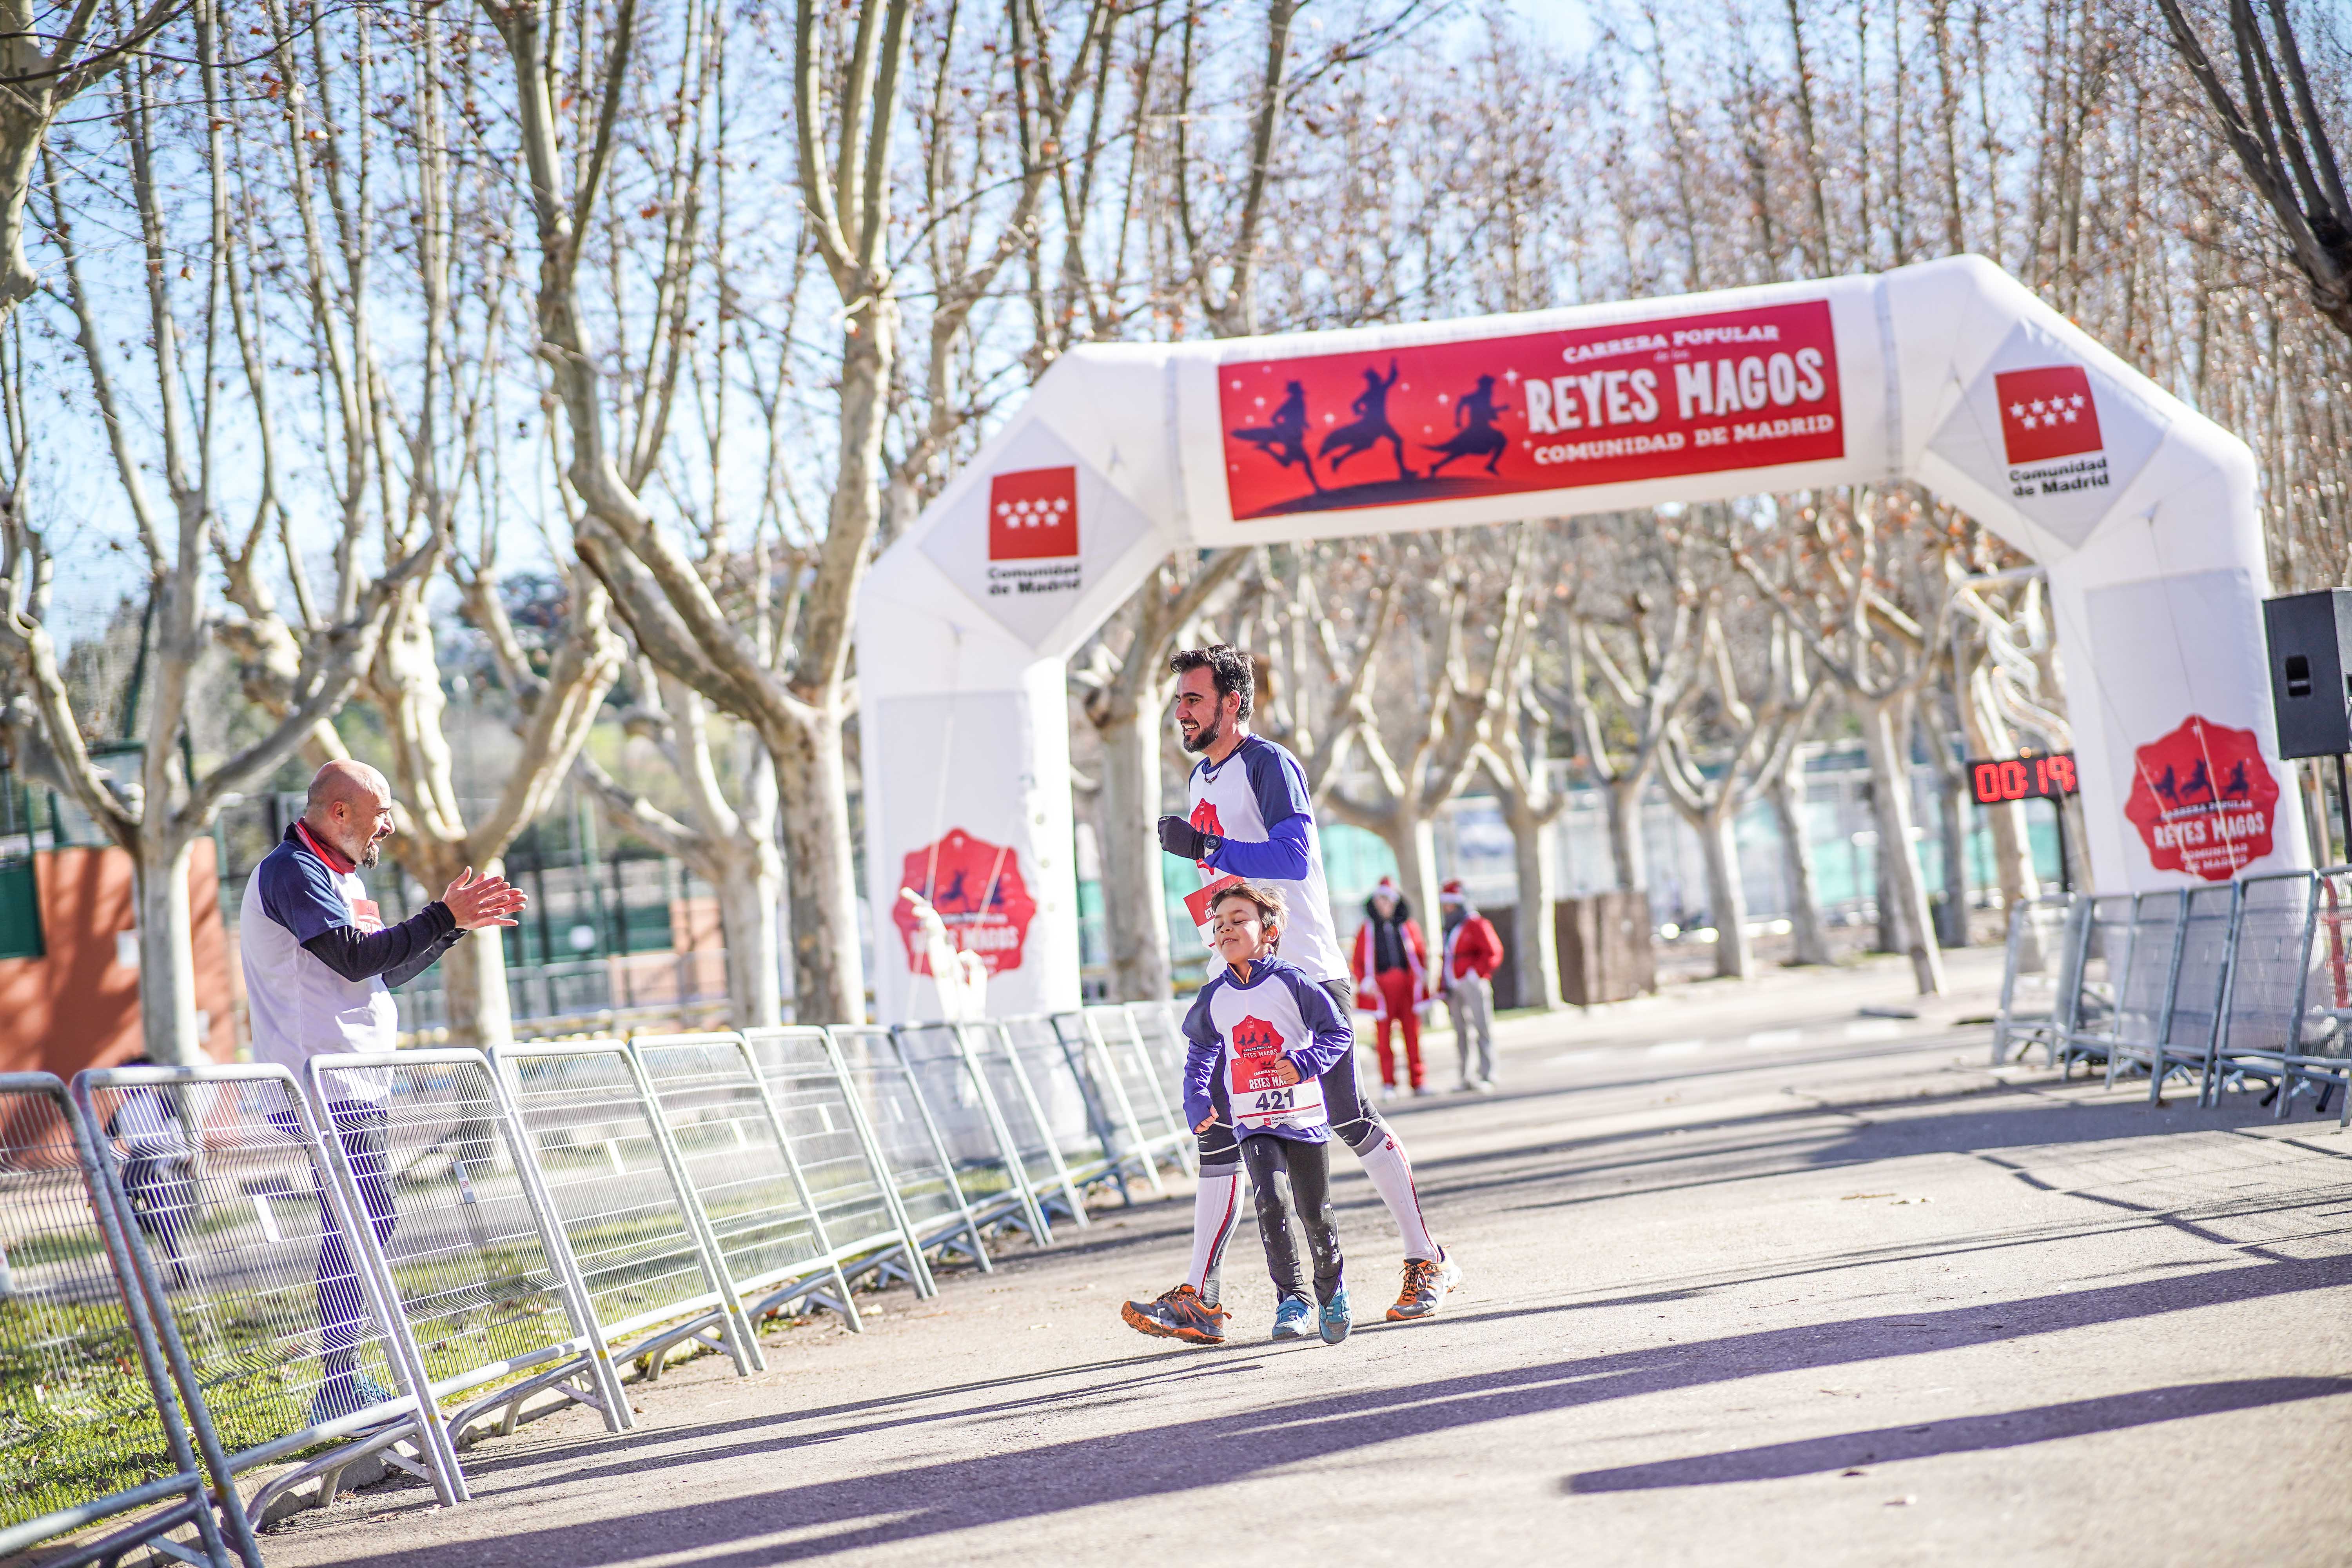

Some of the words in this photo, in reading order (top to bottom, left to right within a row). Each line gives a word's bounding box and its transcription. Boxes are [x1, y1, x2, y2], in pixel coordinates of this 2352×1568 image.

[1562, 334, 1668, 363] CARRERA
[1672, 325, 1779, 346] POPULAR
[1524, 368, 1659, 435] REYES
[1673, 347, 1826, 420] MAGOS
[1534, 432, 1685, 465] COMUNIDAD
[1694, 426, 1729, 446] DE
[1732, 414, 1835, 442] MADRID
[2010, 457, 2107, 481] Comunidad
[2014, 484, 2034, 496] de
[2042, 472, 2109, 493] Madrid
[2153, 820, 2206, 849] REYES
[2211, 811, 2265, 841] MAGOS
[1249, 1077, 1270, 1090] REYES
[1256, 1088, 1294, 1111] 421
